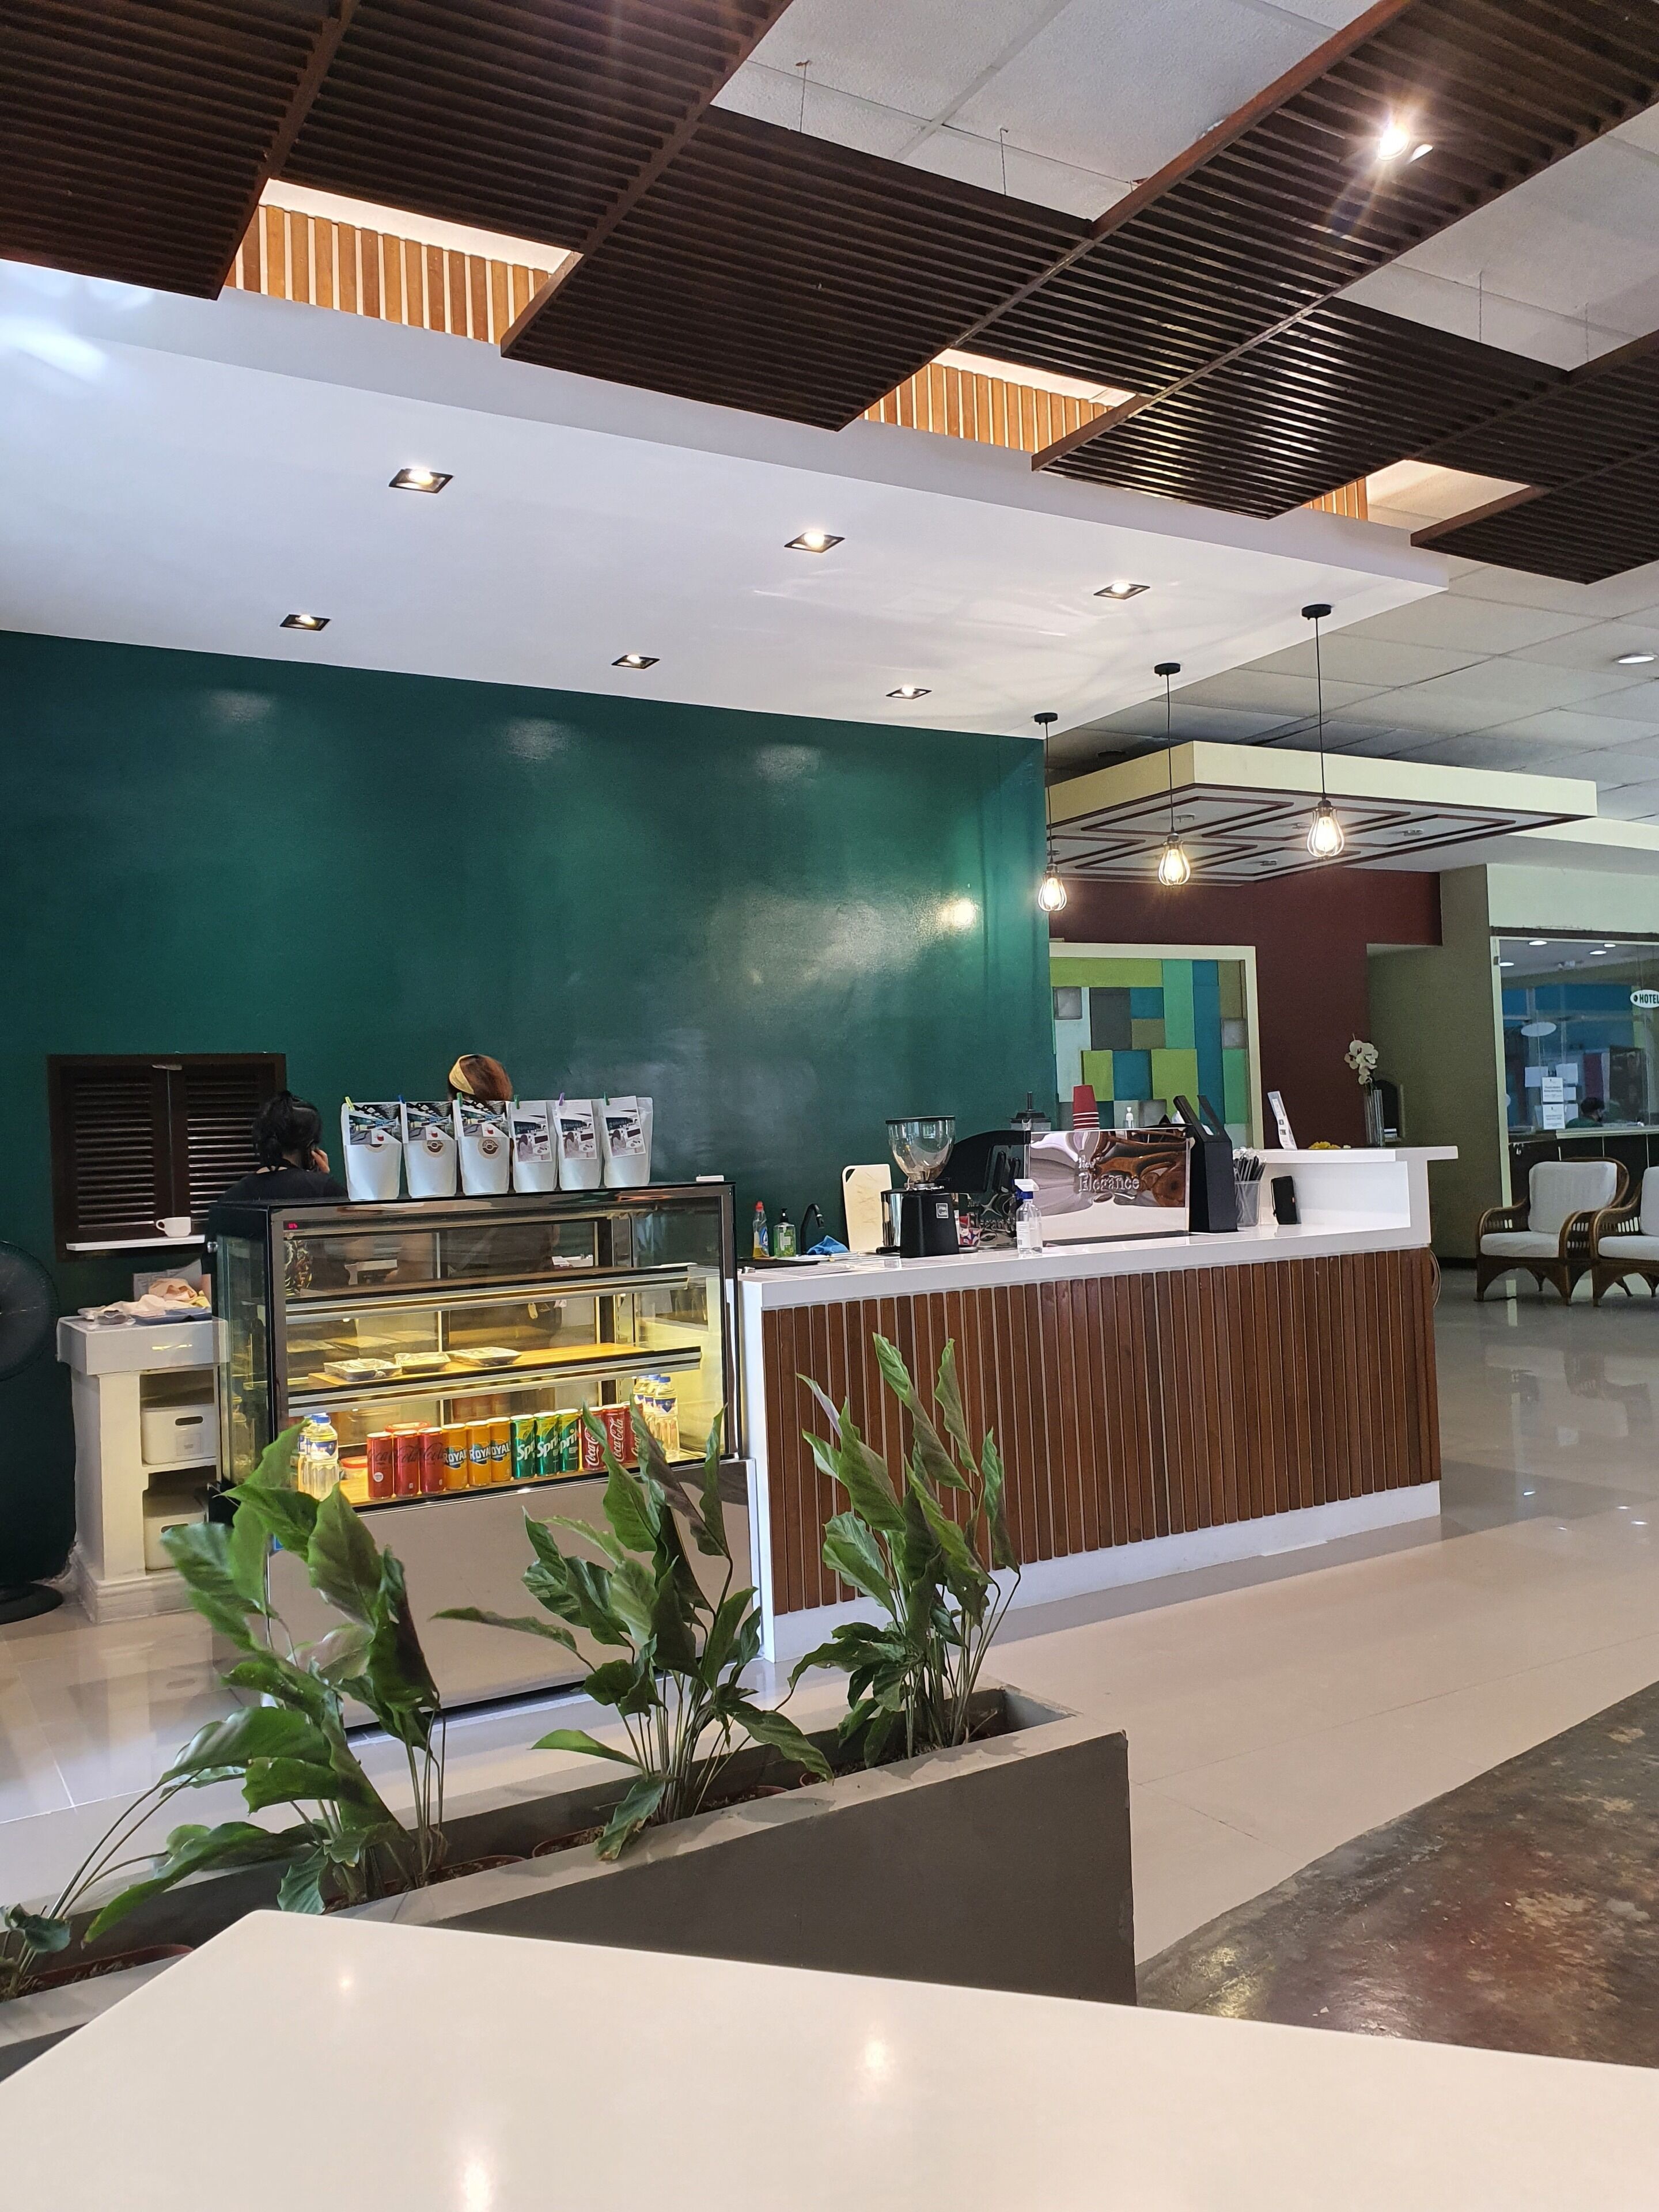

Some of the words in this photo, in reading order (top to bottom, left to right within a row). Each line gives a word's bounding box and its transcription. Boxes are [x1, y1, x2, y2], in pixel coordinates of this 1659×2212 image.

[1639, 993, 1659, 1003] HOTEL
[1078, 1172, 1140, 1192] Elegance
[491, 1442, 510, 1456] OYAL
